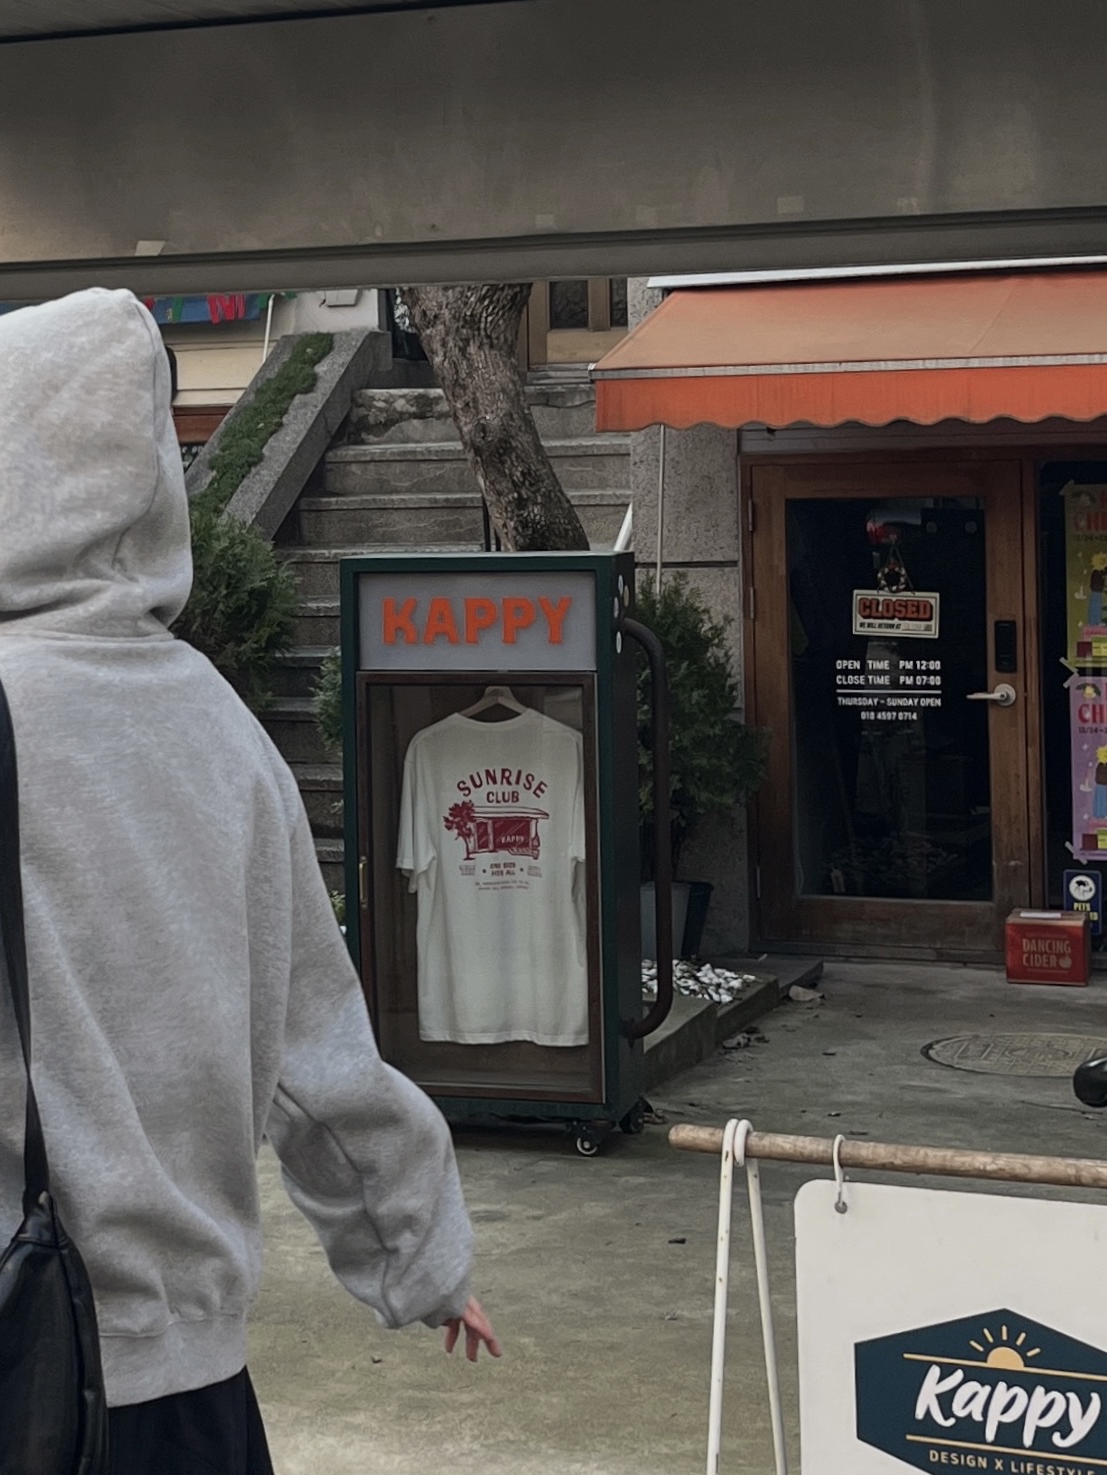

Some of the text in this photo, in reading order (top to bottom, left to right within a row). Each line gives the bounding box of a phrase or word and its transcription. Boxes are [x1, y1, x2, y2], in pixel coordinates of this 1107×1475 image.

[858, 597, 933, 621] CLOSED
[383, 596, 573, 645] KAPPY
[836, 660, 941, 670] OPEN TIME PM 12:00
[836, 675, 941, 686] CLOSE TIME PM 07:00
[837, 697, 878, 706] THURSDAY
[887, 697, 918, 706] SUNDAY
[920, 697, 941, 707] OPEN
[861, 711, 875, 720] 010
[1078, 703, 1107, 724] CH
[457, 768, 548, 798] SUNRISE
[486, 791, 520, 804] CLUB
[1022, 939, 1072, 954] DANCING
[1022, 953, 1057, 968] CIDER
[915, 1364, 1101, 1448] Kappy
[929, 1450, 988, 1469] DESIGN
